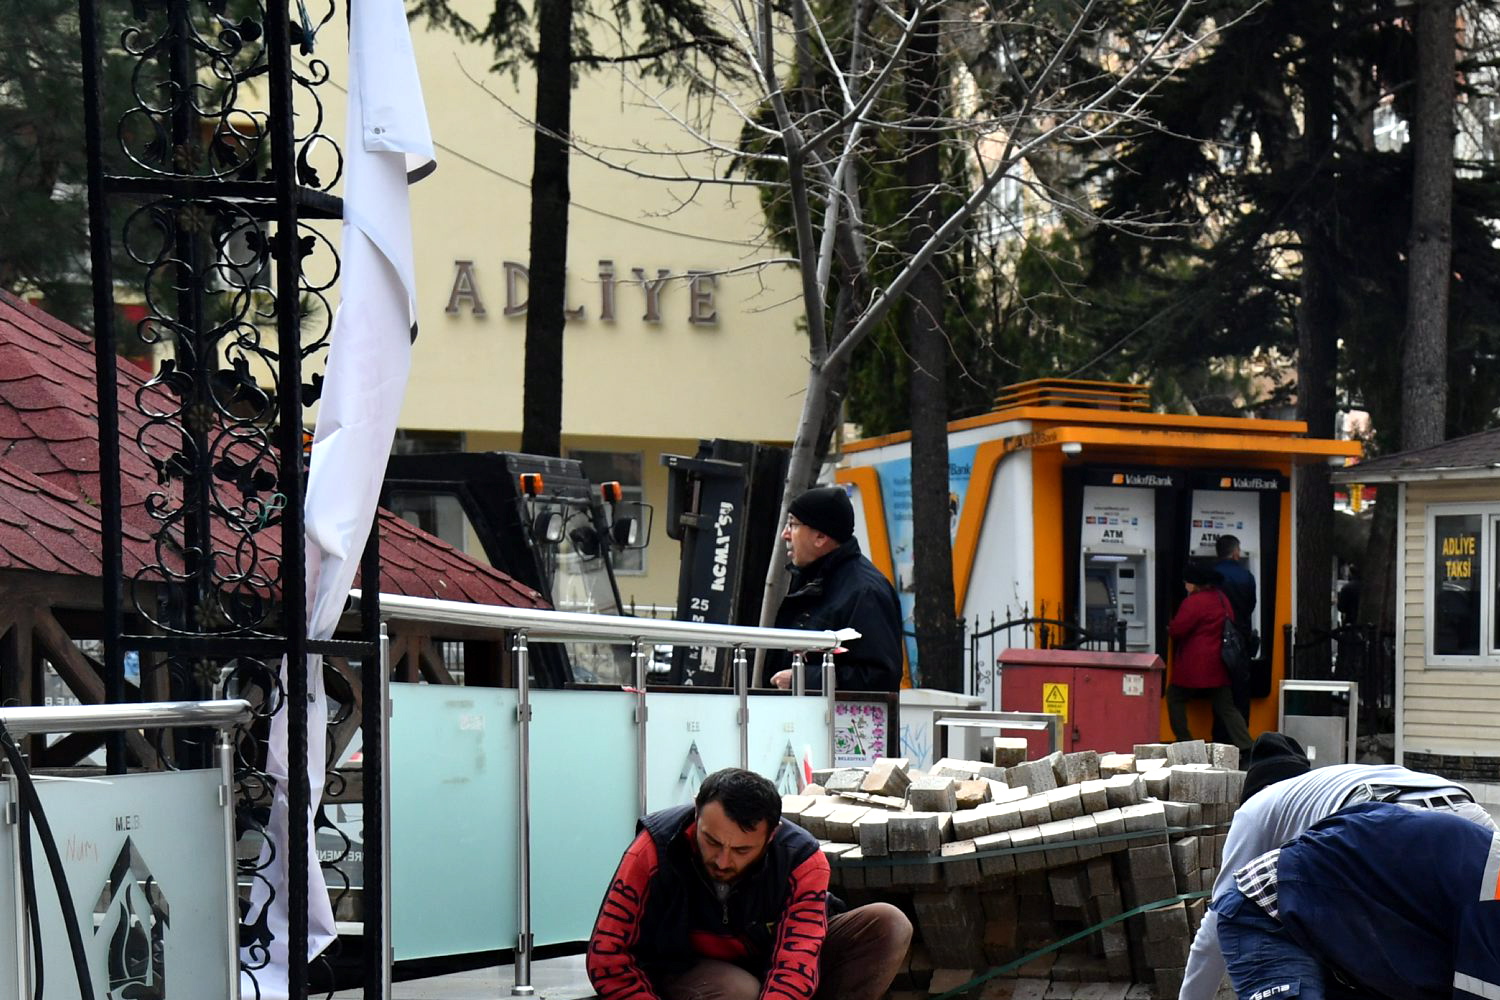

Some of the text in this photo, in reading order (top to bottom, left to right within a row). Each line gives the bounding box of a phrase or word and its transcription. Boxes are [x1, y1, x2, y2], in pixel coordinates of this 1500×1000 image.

[1103, 529, 1123, 539] ATM
[1442, 534, 1476, 556] ADLİYE
[1446, 558, 1471, 577] TAKSİ
[690, 597, 710, 611] 25
